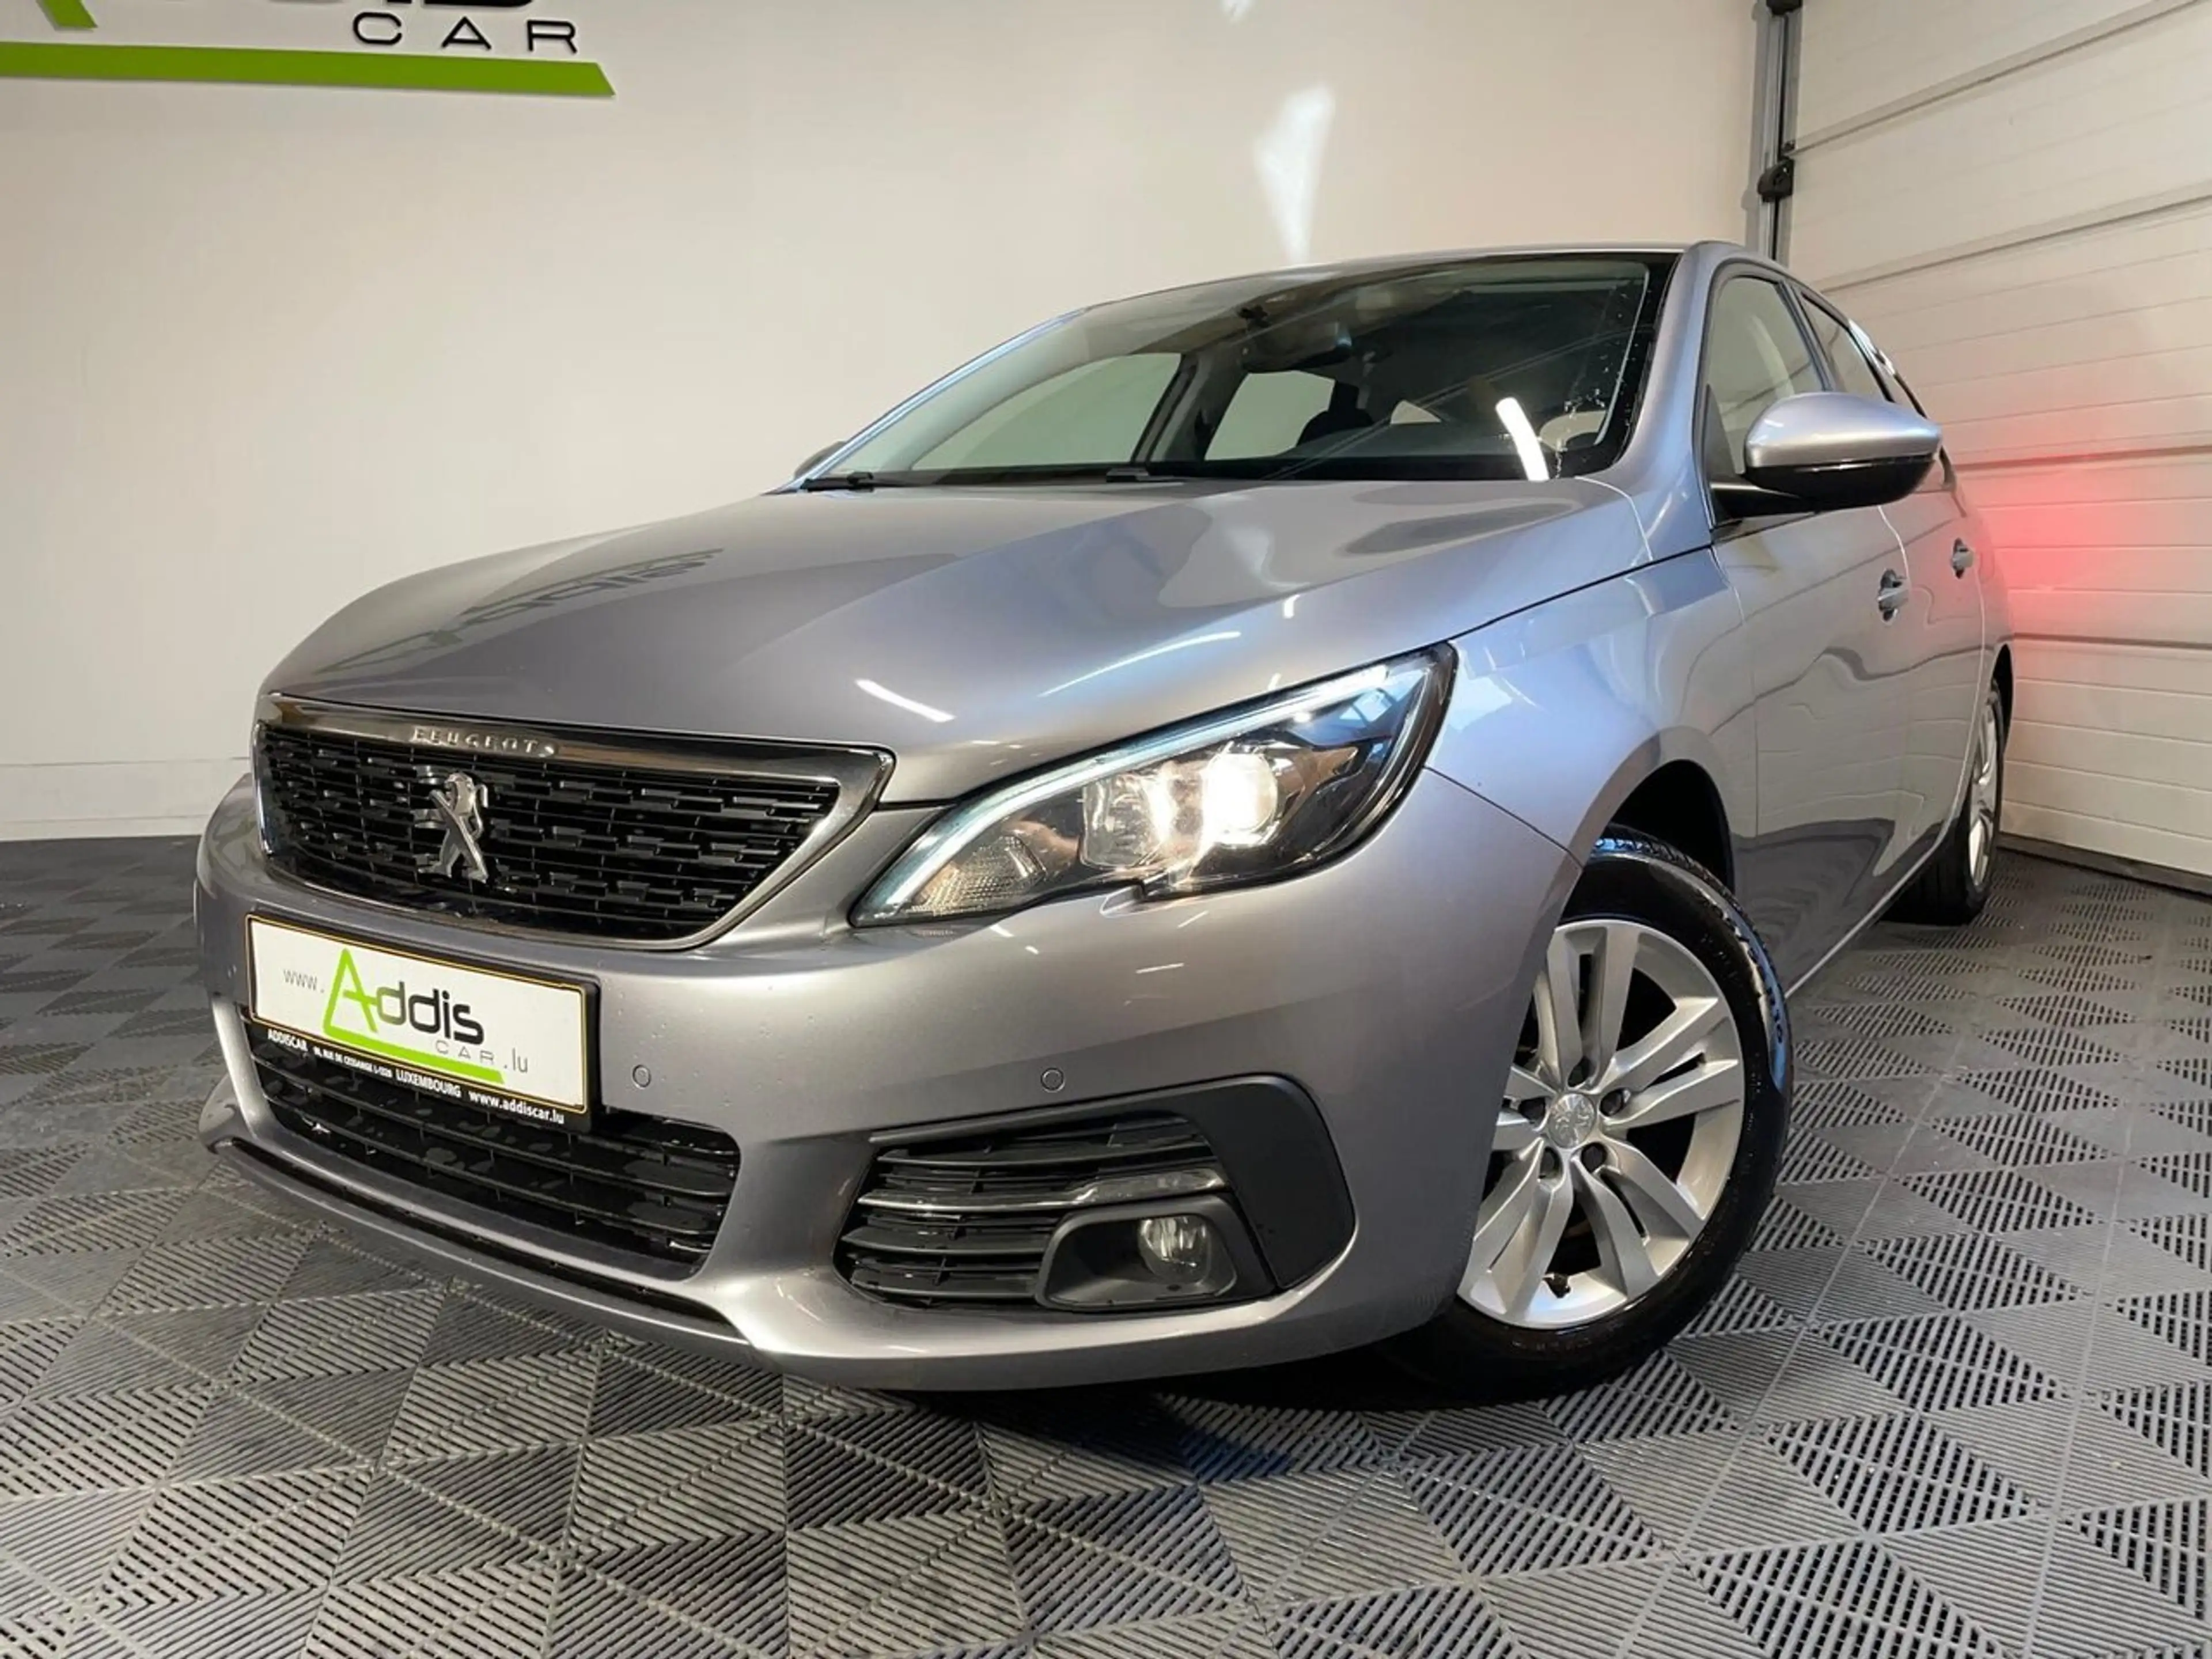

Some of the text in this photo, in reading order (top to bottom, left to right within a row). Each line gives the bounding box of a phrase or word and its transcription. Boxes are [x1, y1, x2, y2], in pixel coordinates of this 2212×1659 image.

[352, 12, 578, 54] CAR
[409, 724, 539, 753] PEUGEOT
[323, 947, 485, 1046] Addis
[435, 1039, 495, 1066] CAR
[395, 1067, 461, 1098] LUXEMBOURG
[468, 1090, 565, 1124] www.addiscar.lu
